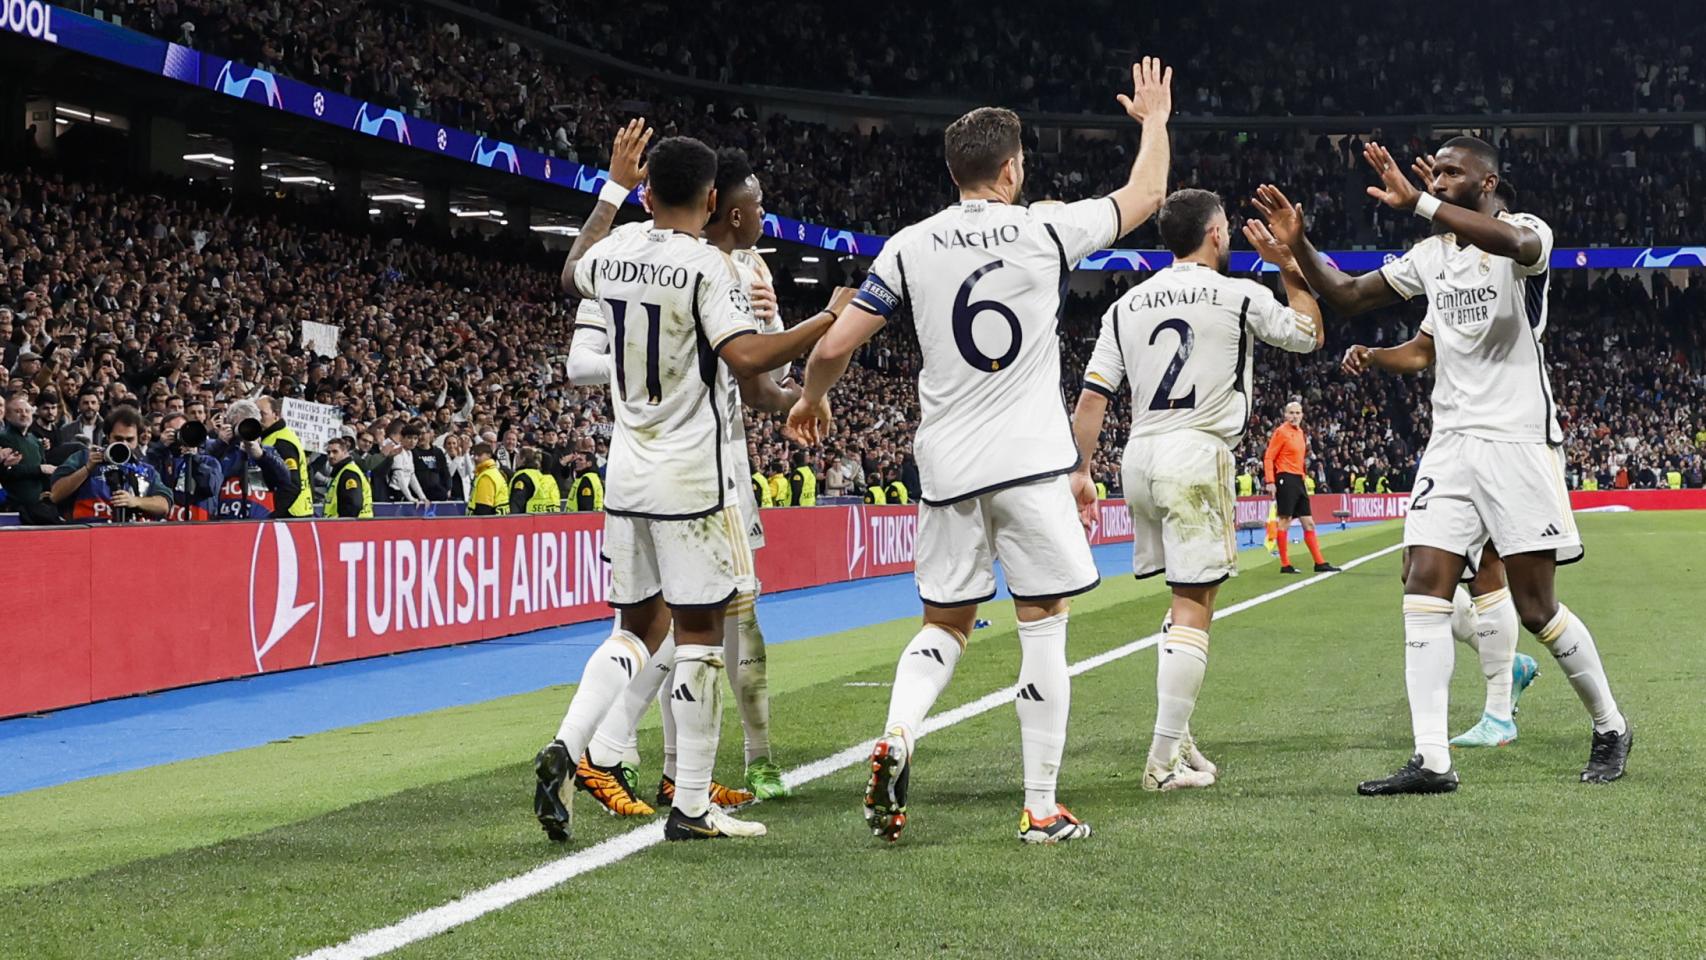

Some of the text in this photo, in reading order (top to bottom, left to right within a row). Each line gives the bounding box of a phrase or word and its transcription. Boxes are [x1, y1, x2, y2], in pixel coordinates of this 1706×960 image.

[932, 224, 1019, 251] NACHO
[600, 258, 688, 289] RODRYGO
[1129, 287, 1223, 312] CARVAJAL
[1436, 284, 1498, 310] Emirates
[952, 259, 1022, 374] 6
[1457, 305, 1488, 325] BETTER
[603, 298, 662, 406] 11
[1148, 318, 1196, 411] 2
[1352, 497, 1385, 518] TURKISH
[1410, 476, 1435, 511] 2
[1101, 505, 1132, 538] TURKISH
[339, 536, 500, 638] TURKISH
